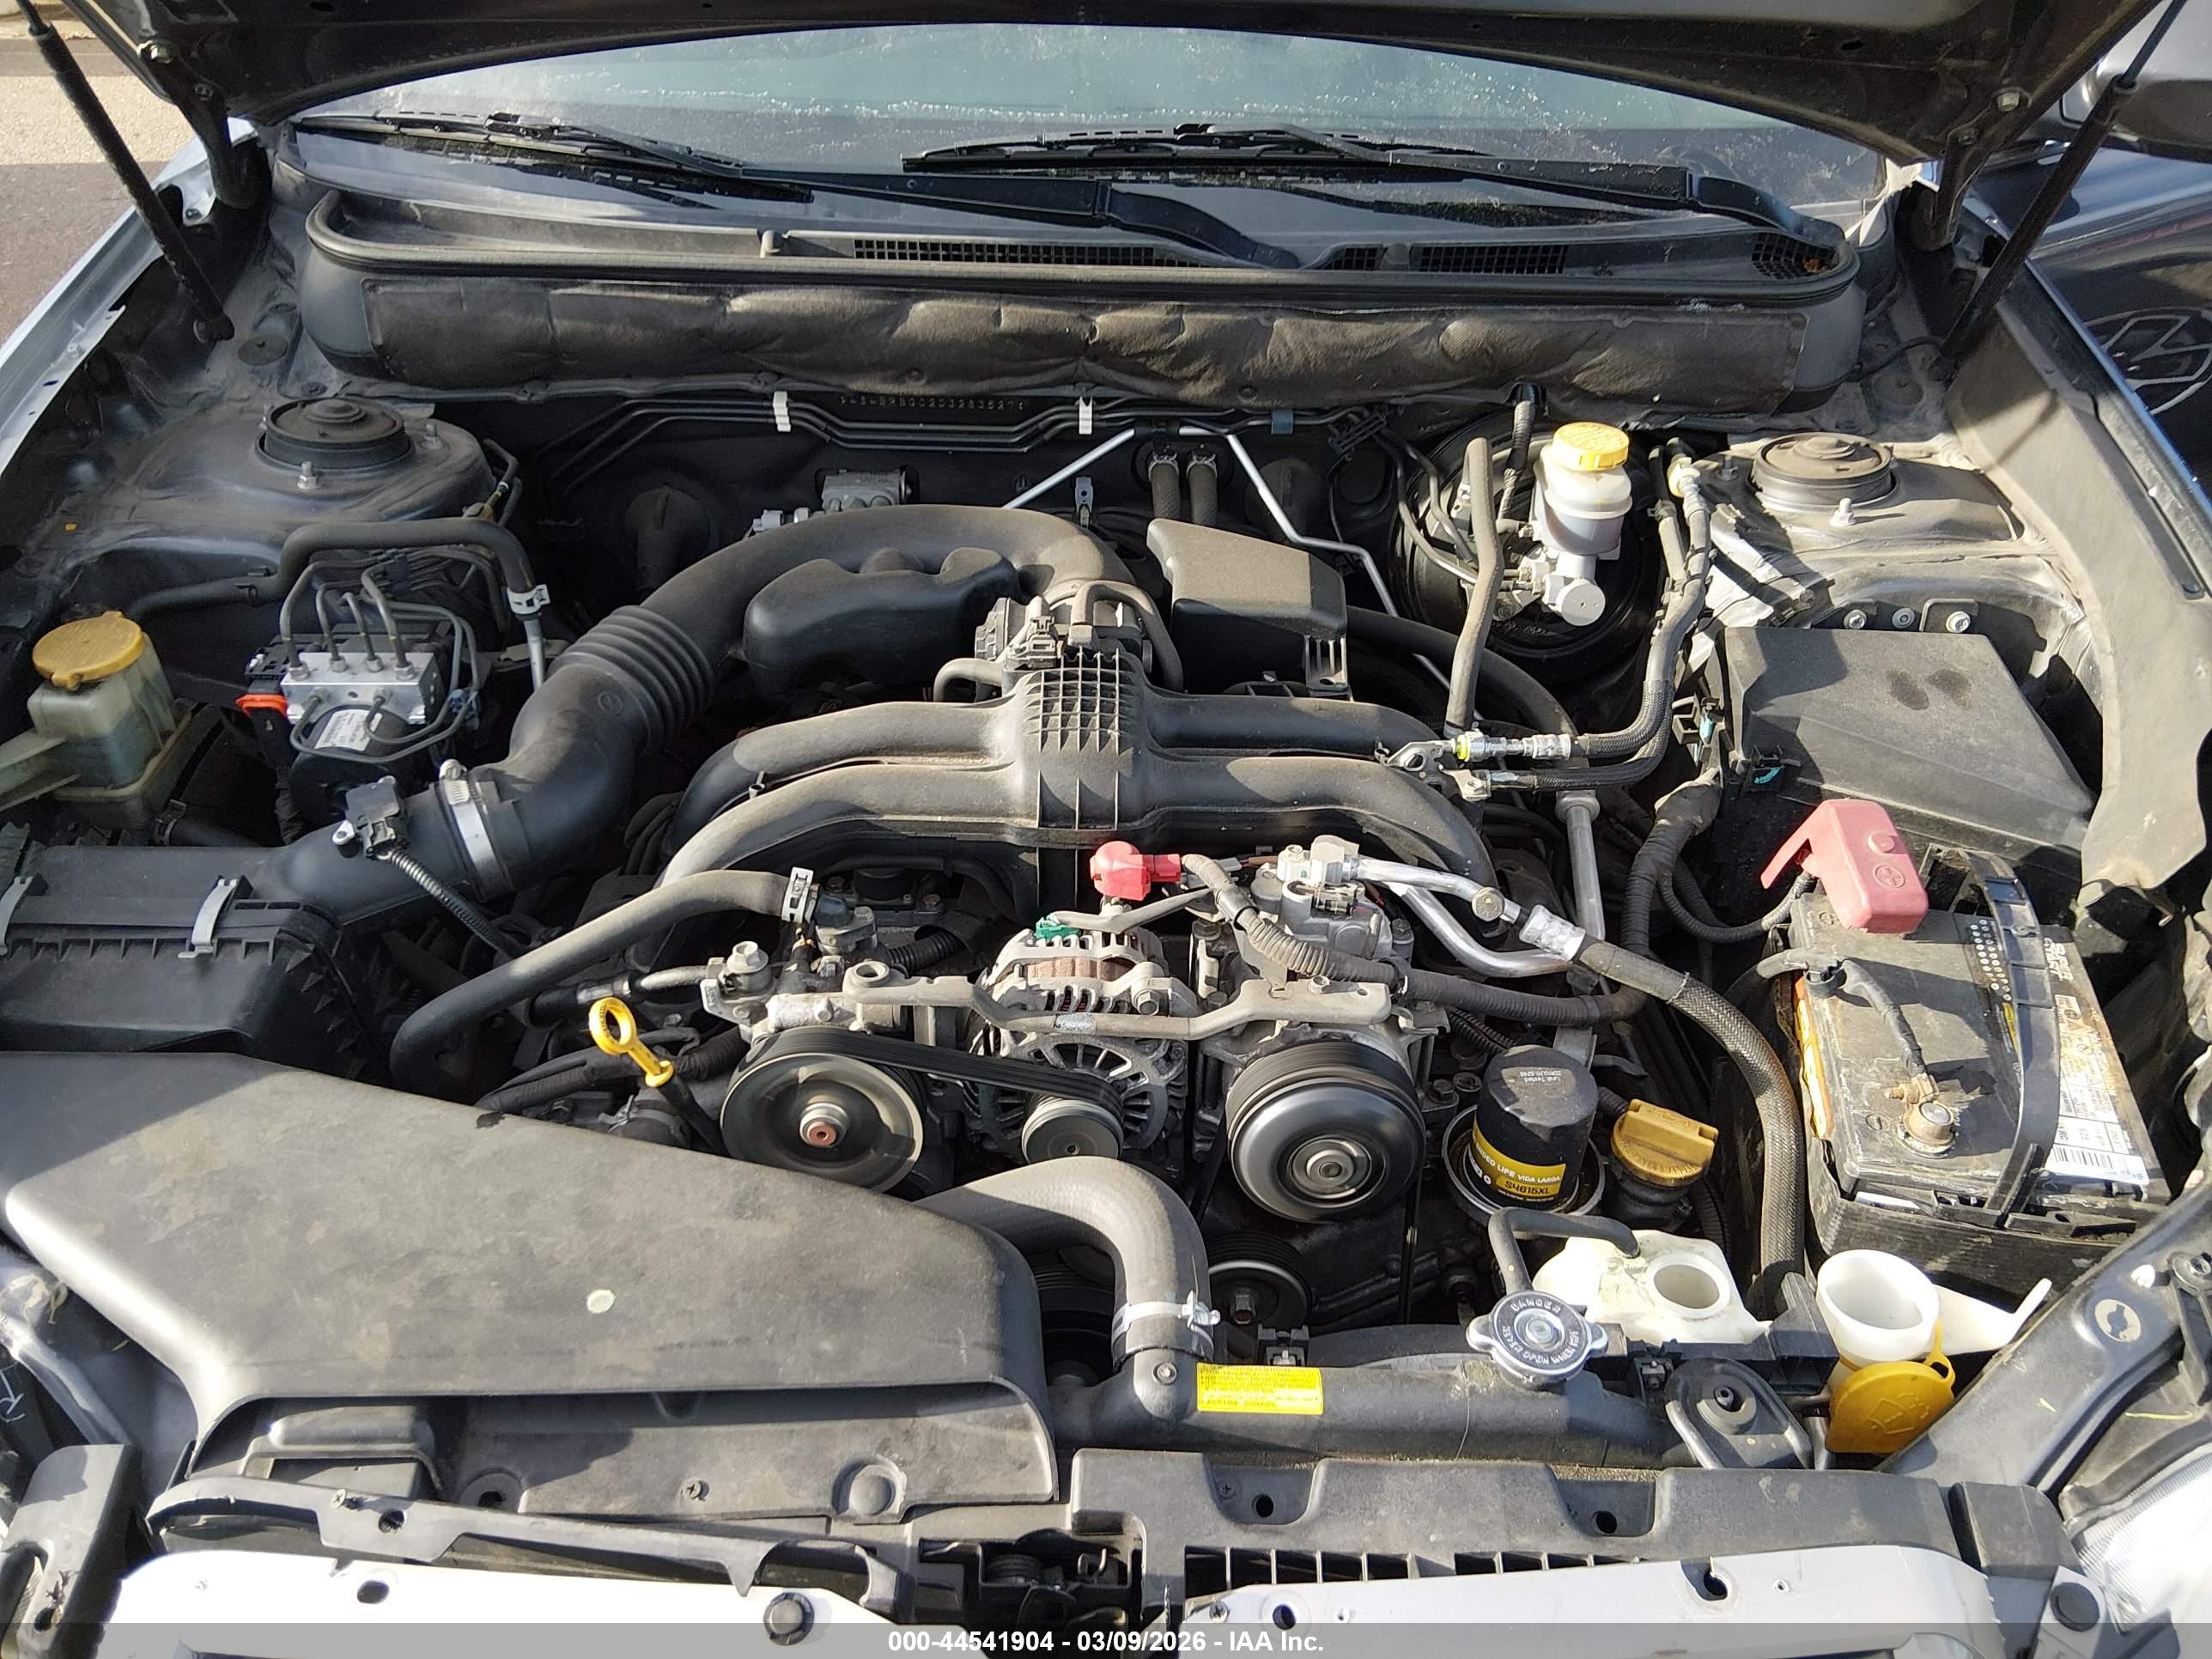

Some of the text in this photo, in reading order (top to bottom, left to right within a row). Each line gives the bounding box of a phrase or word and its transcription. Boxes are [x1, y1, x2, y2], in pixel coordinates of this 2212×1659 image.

[1497, 1164, 1516, 1177] LIFE
[1517, 1174, 1535, 1182] VIDA
[1510, 1297, 1562, 1315] DANGER
[1502, 1325, 1524, 1353] NEVER
[1522, 1350, 1550, 1365] OPEN
[1550, 1346, 1577, 1364] WHEN
